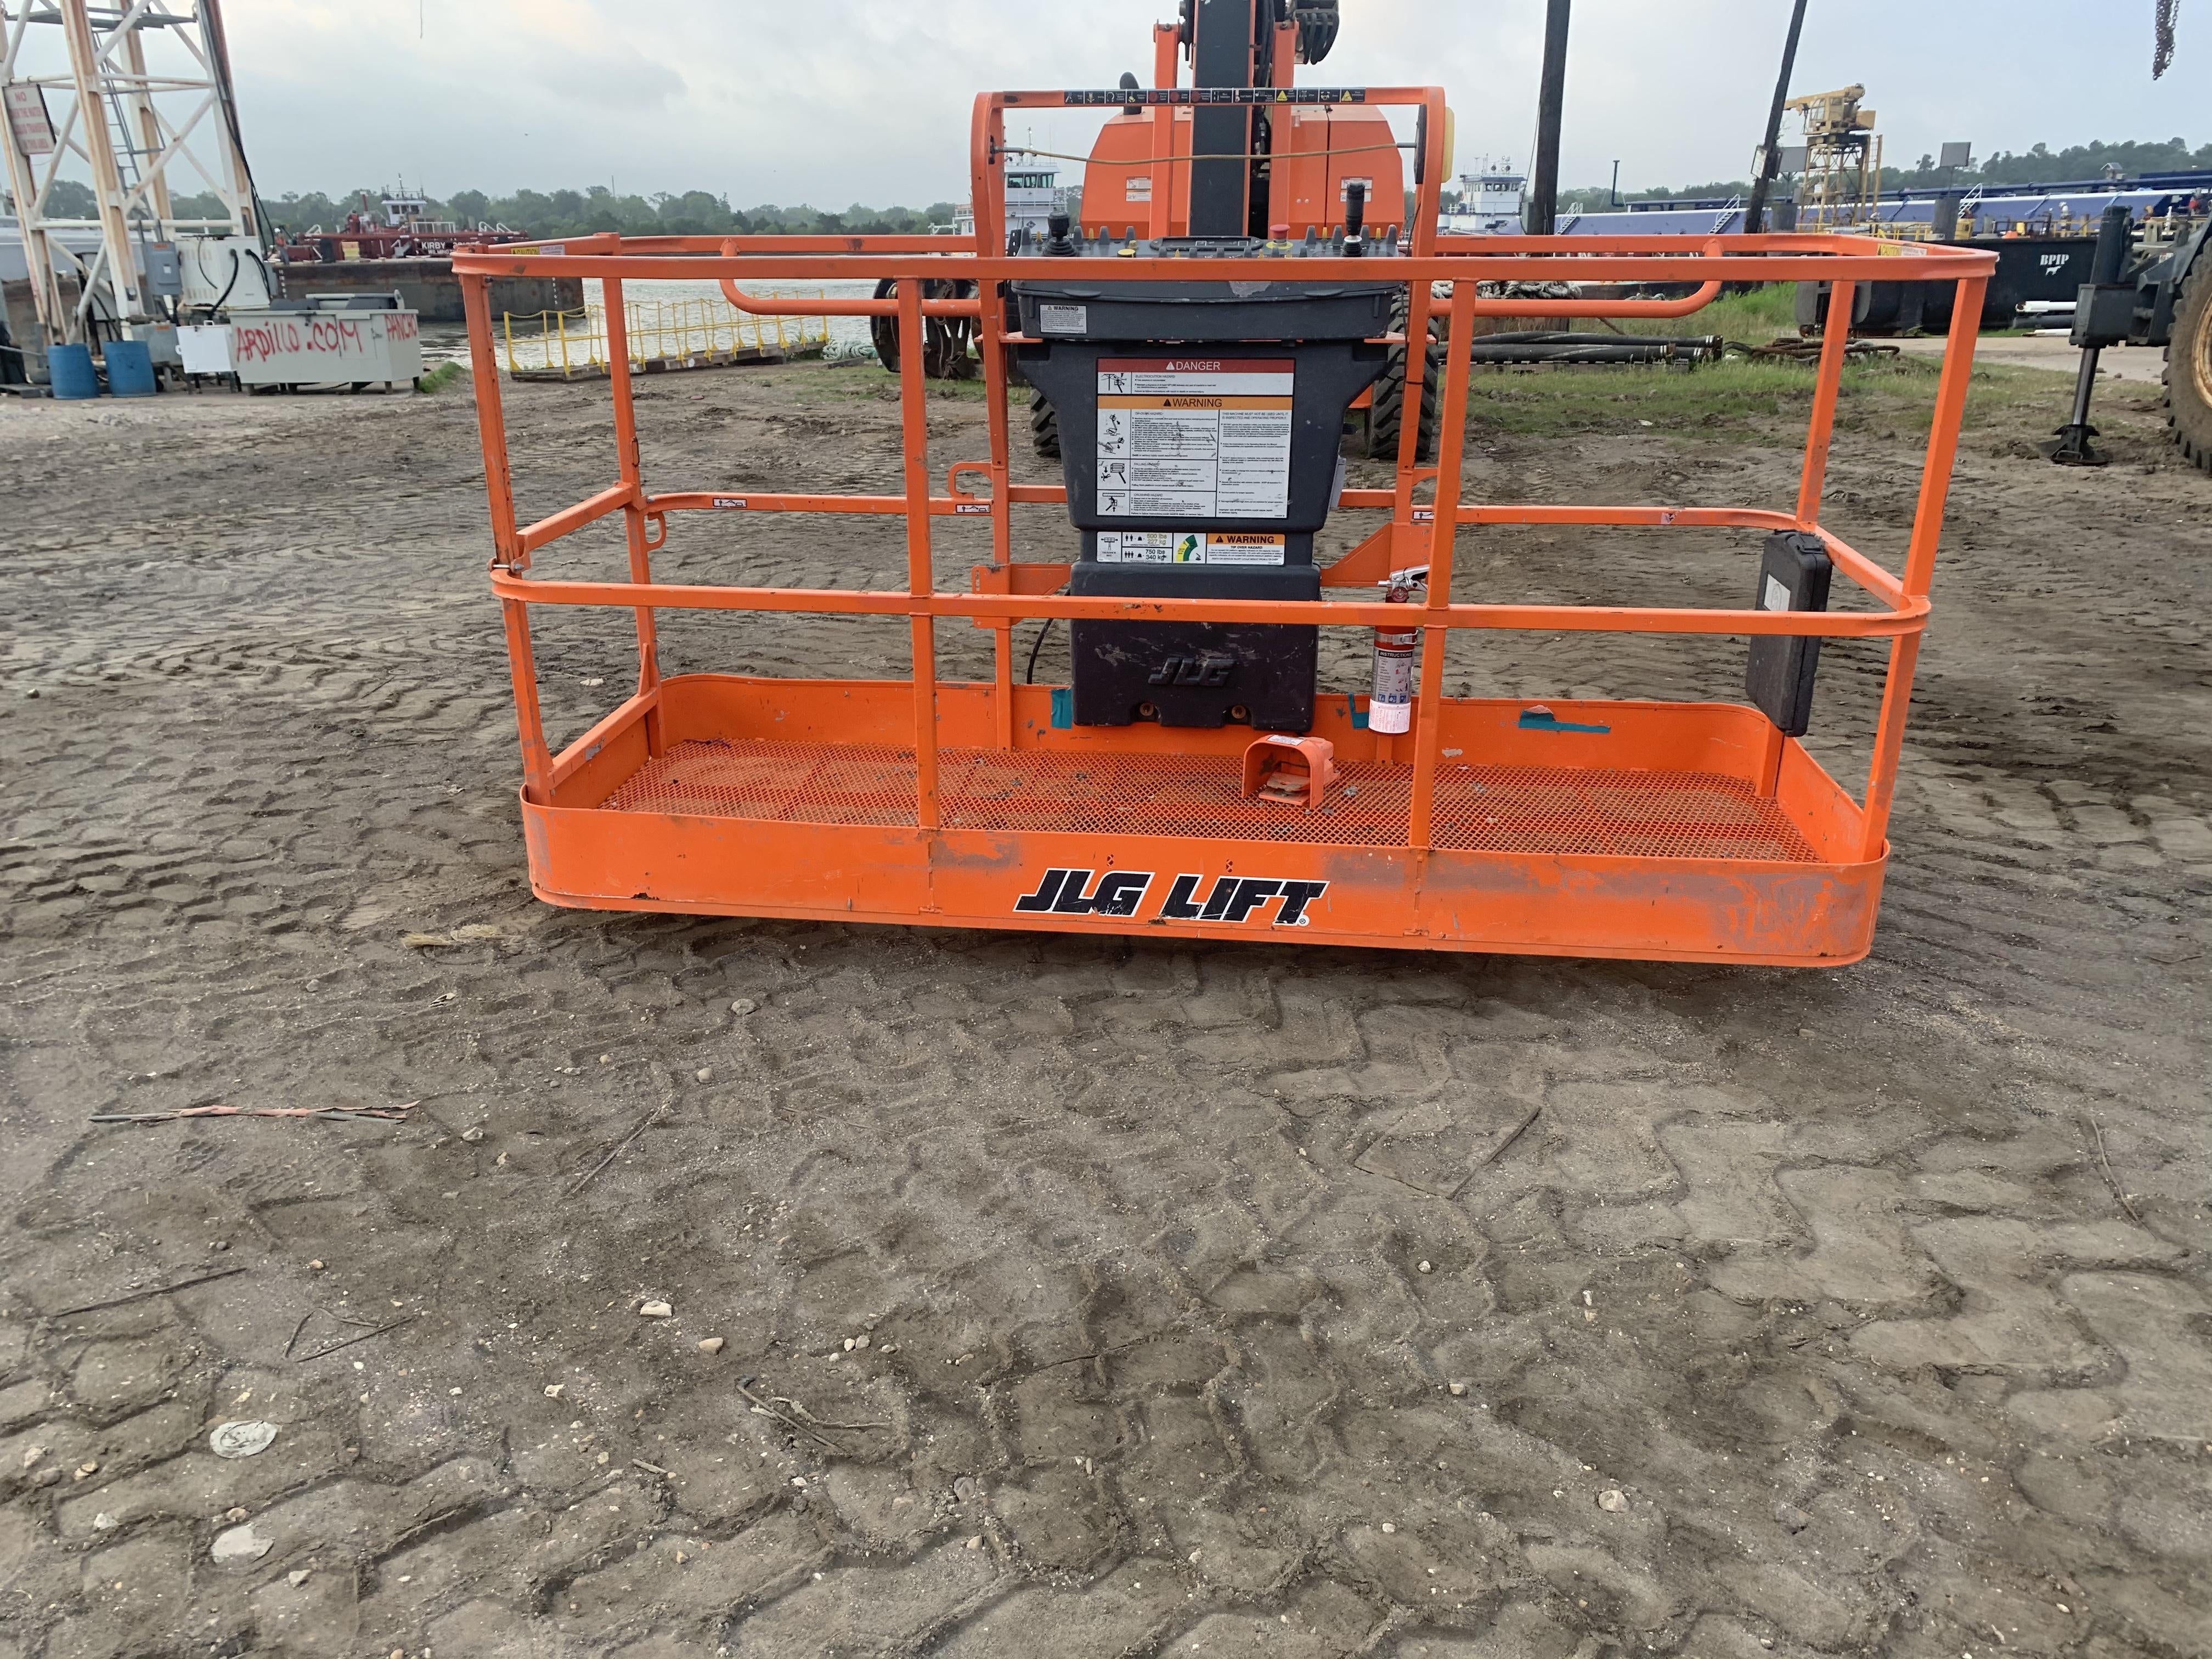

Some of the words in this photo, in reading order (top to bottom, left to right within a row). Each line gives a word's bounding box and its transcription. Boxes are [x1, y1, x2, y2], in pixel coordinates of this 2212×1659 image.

[14, 91, 27, 102] NO
[2040, 254, 2070, 266] BPIP
[1176, 361, 1221, 370] DANGER
[1172, 398, 1222, 407] WARNING
[1227, 535, 1274, 544] WARNING
[1148, 658, 1237, 686] JLG
[1013, 868, 1155, 917] JLG
[1158, 873, 1330, 926] LIFT
